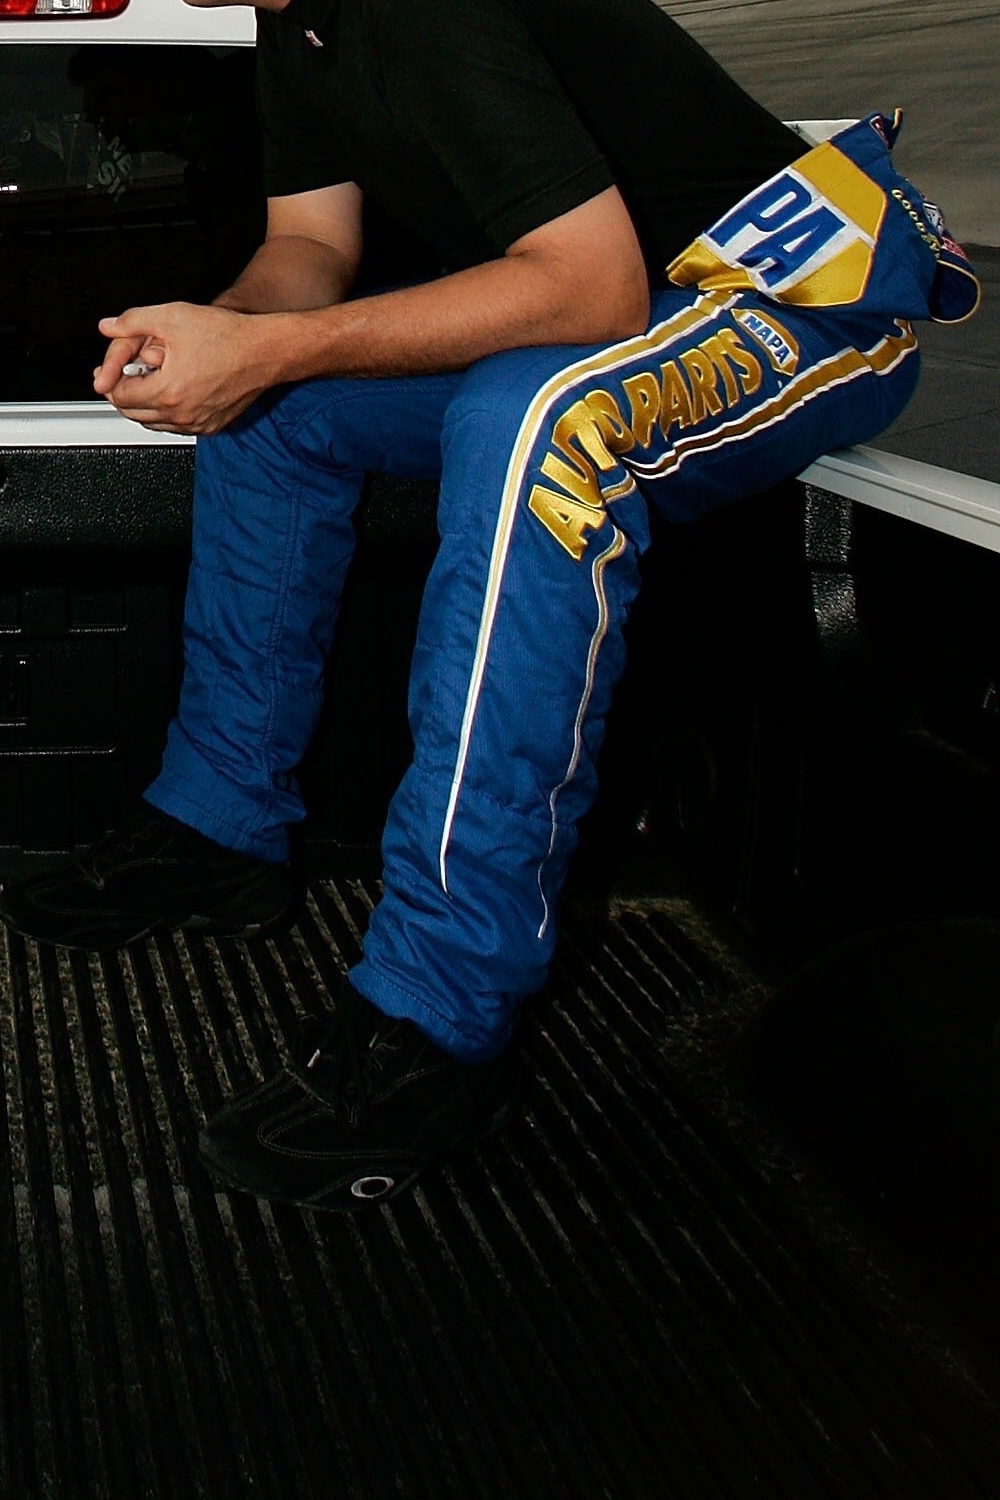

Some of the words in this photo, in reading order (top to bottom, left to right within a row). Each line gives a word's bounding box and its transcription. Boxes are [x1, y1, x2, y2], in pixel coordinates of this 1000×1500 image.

[743, 313, 792, 366] NAPA
[528, 389, 636, 561] AUTO
[622, 327, 763, 449] PARTS
